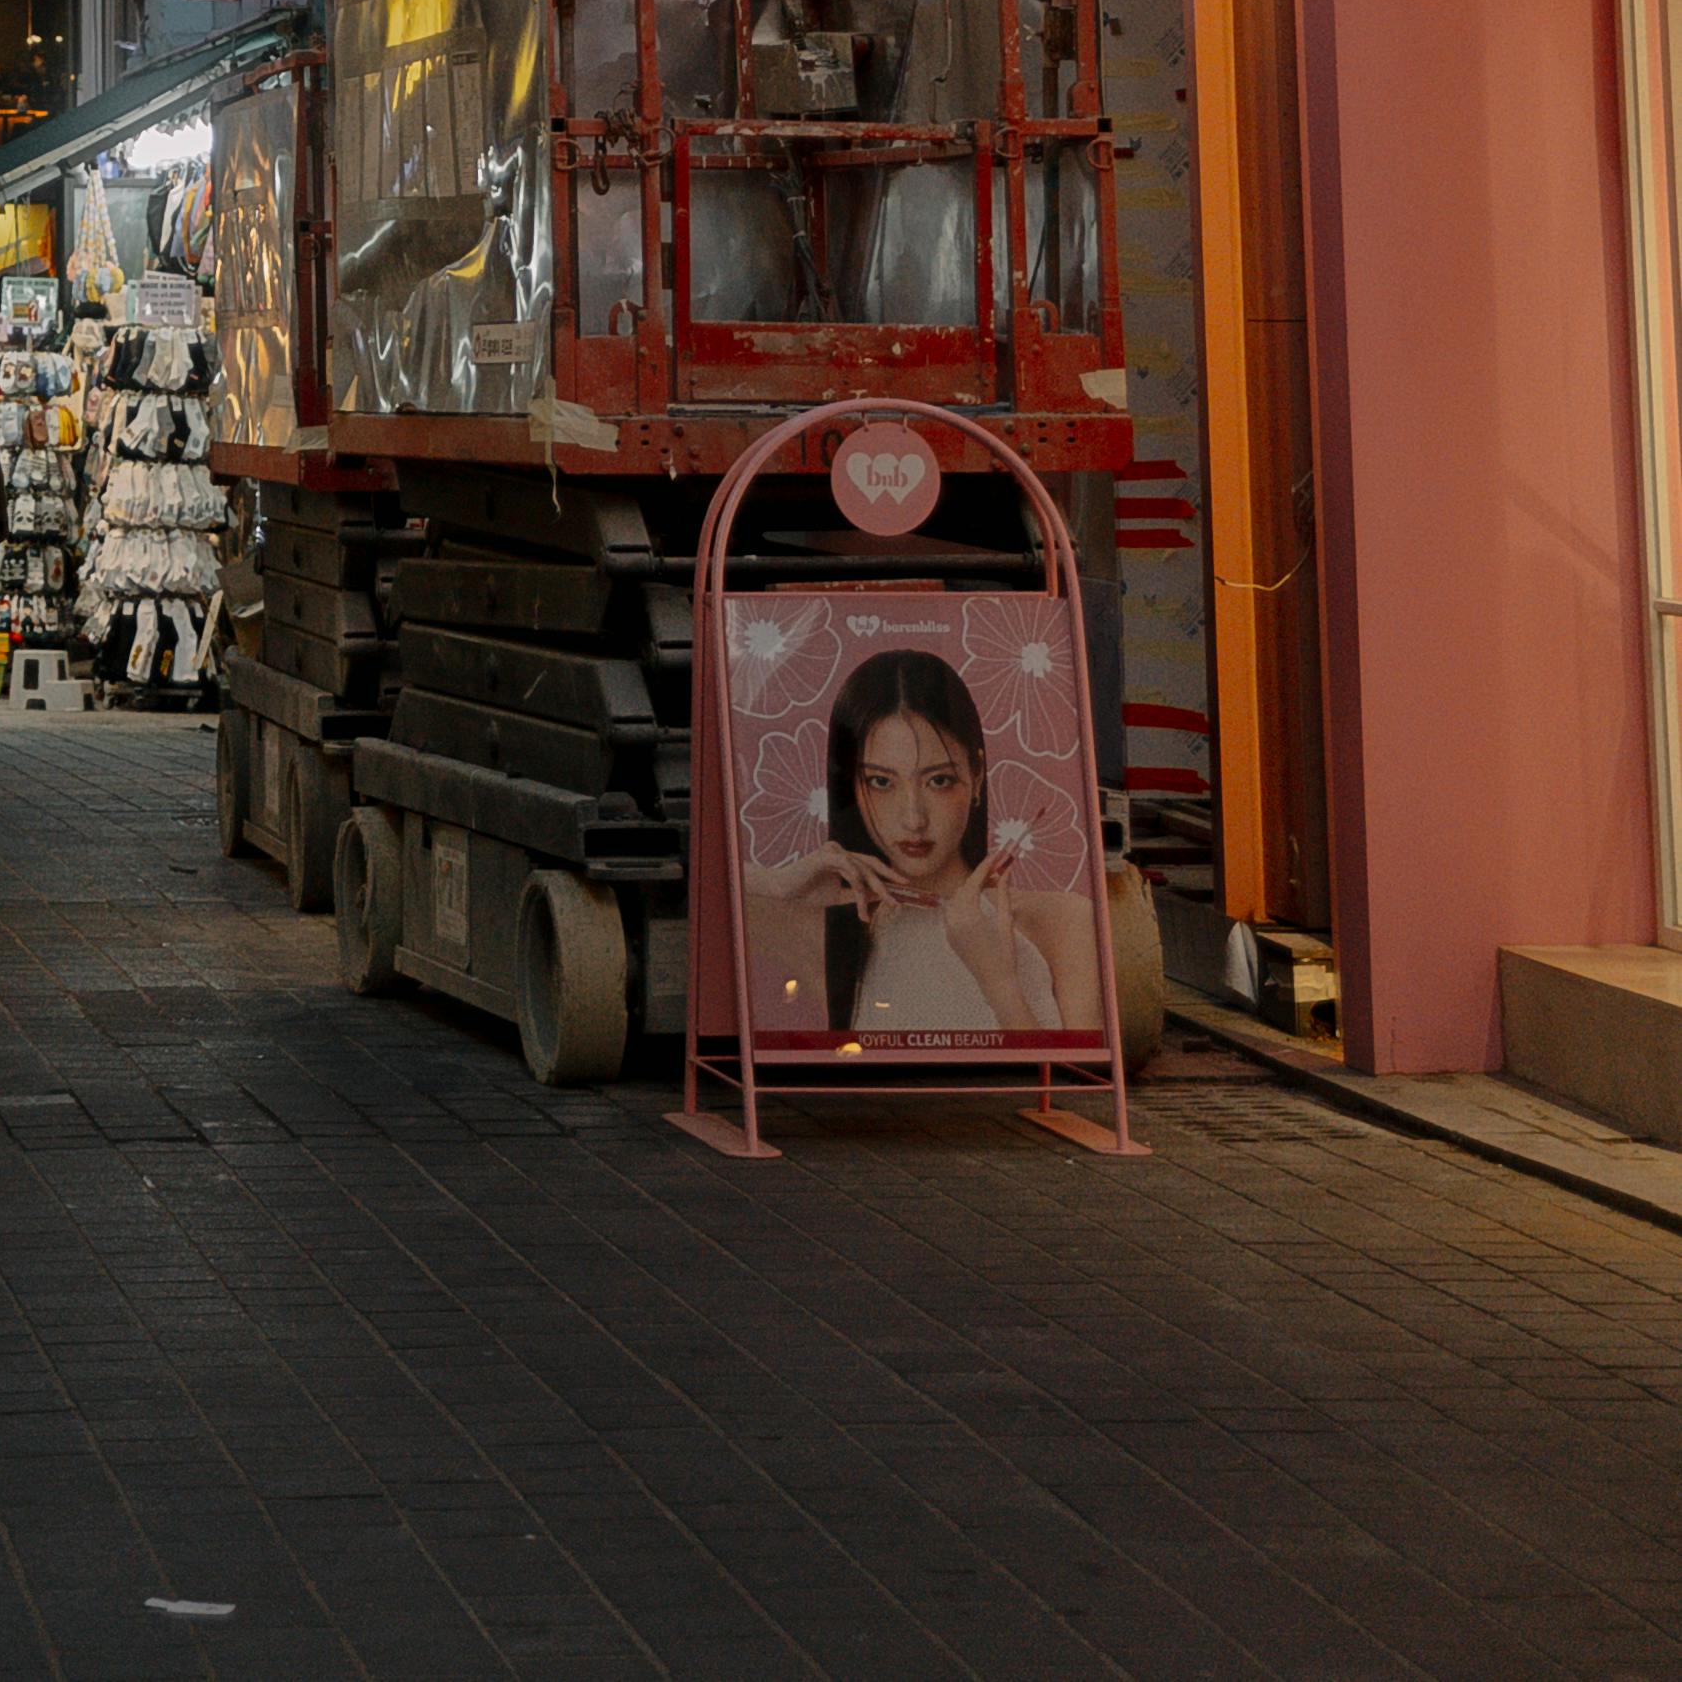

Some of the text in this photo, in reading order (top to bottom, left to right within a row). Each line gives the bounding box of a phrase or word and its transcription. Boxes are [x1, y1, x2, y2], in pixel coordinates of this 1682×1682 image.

[867, 464, 909, 487] bnb
[883, 620, 950, 633] barenbliss
[907, 1033, 952, 1047] CLEAN
[955, 1033, 1004, 1047] BEAUTY
